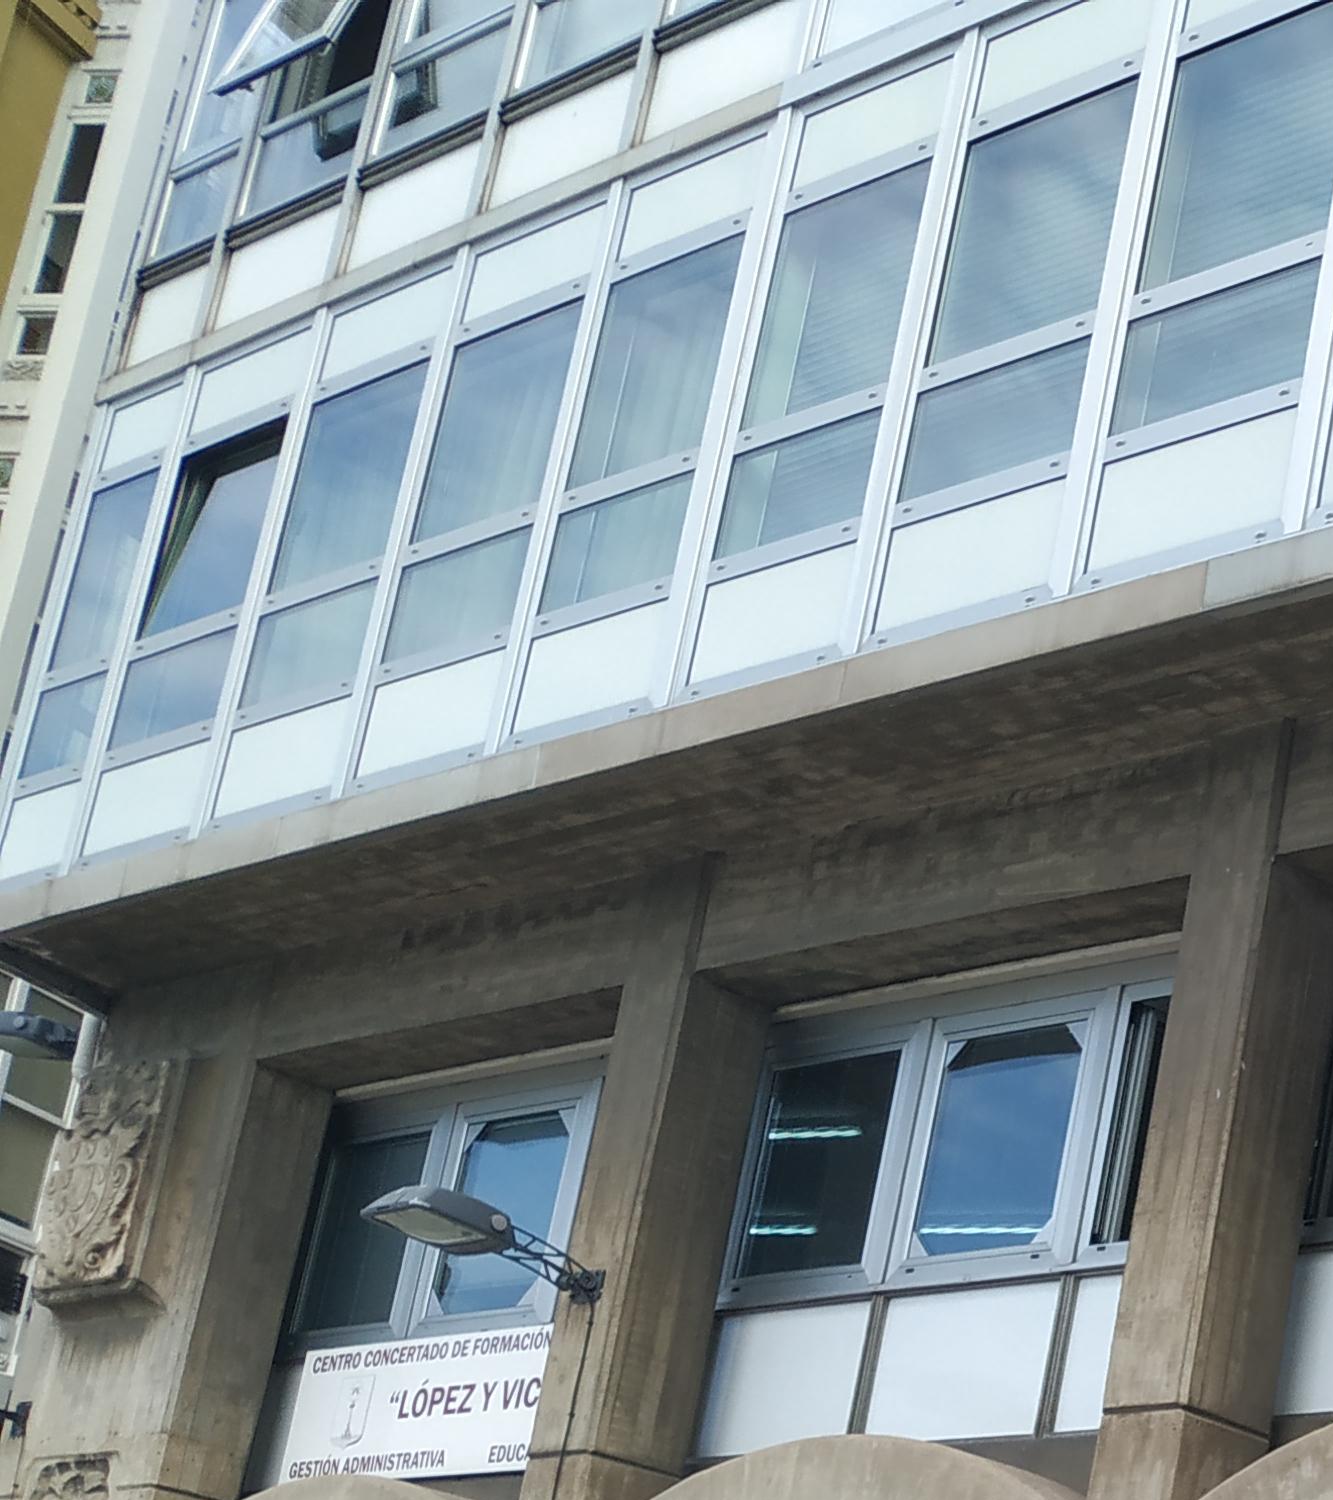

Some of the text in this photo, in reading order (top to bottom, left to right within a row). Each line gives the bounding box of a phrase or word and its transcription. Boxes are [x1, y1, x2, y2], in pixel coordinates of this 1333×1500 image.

[313, 1352, 362, 1374] CENTRO
[364, 1342, 449, 1368] CONCERTADO
[451, 1339, 471, 1358] DE
[482, 1381, 498, 1412] Y
[503, 1377, 541, 1410] VIC
[289, 1454, 340, 1479] GESTIÓN
[342, 1450, 445, 1474] ADMINISTRATIVA
